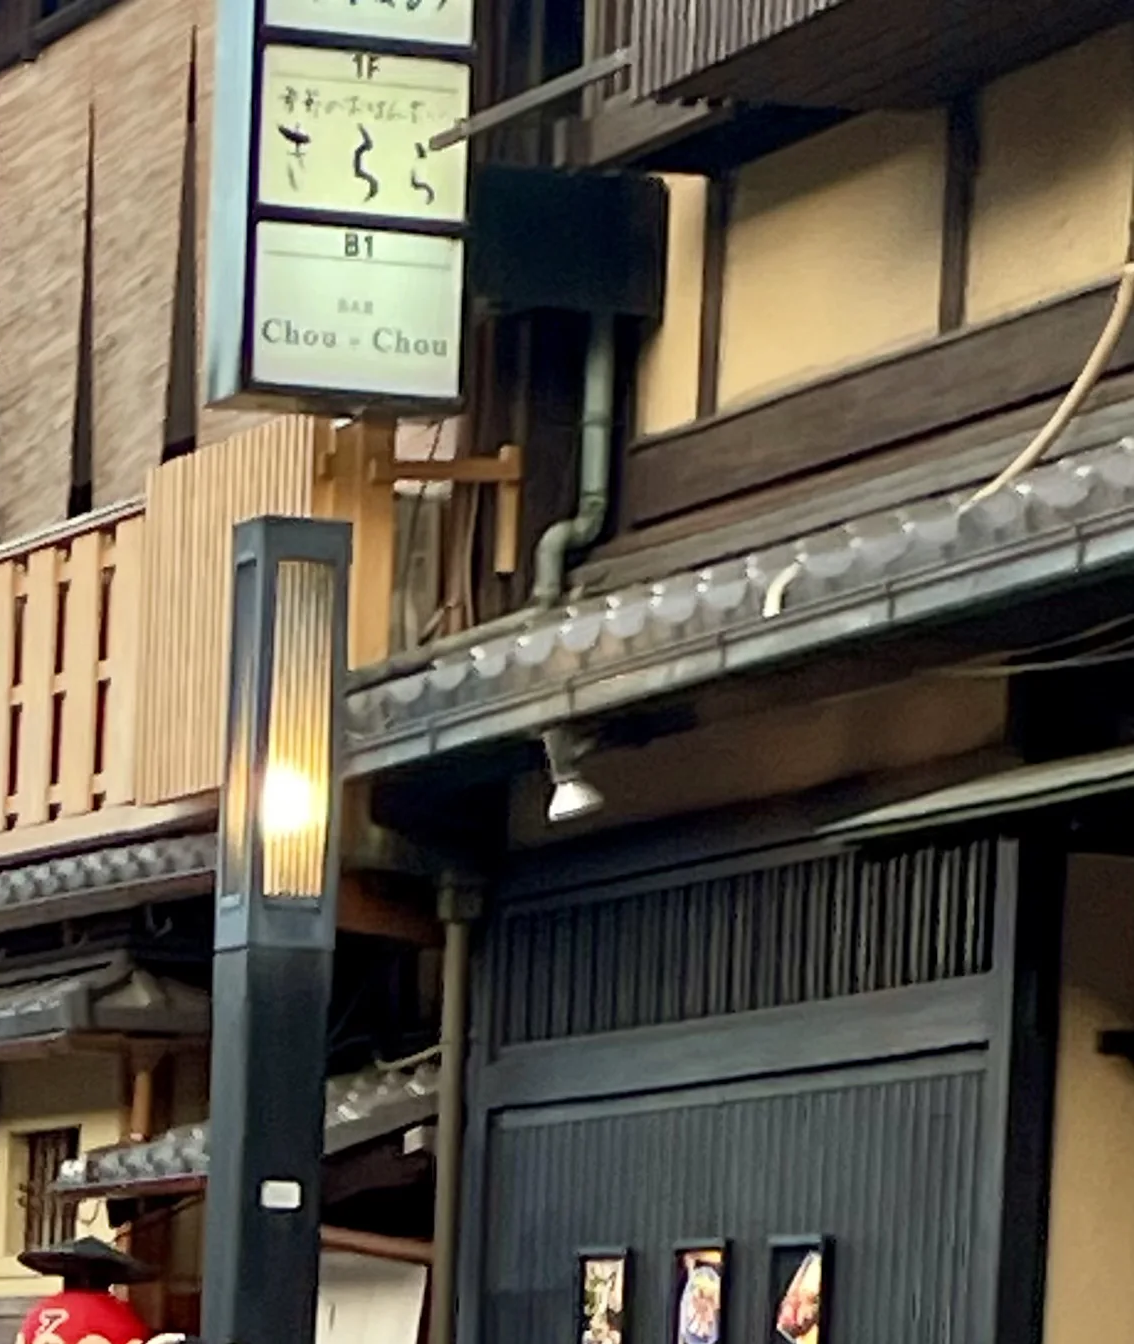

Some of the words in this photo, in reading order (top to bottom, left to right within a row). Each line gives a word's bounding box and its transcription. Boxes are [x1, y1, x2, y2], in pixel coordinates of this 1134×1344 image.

[353, 53, 380, 79] 1F
[344, 232, 374, 257] B1
[261, 318, 337, 349] Chou
[372, 326, 448, 357] Chou
